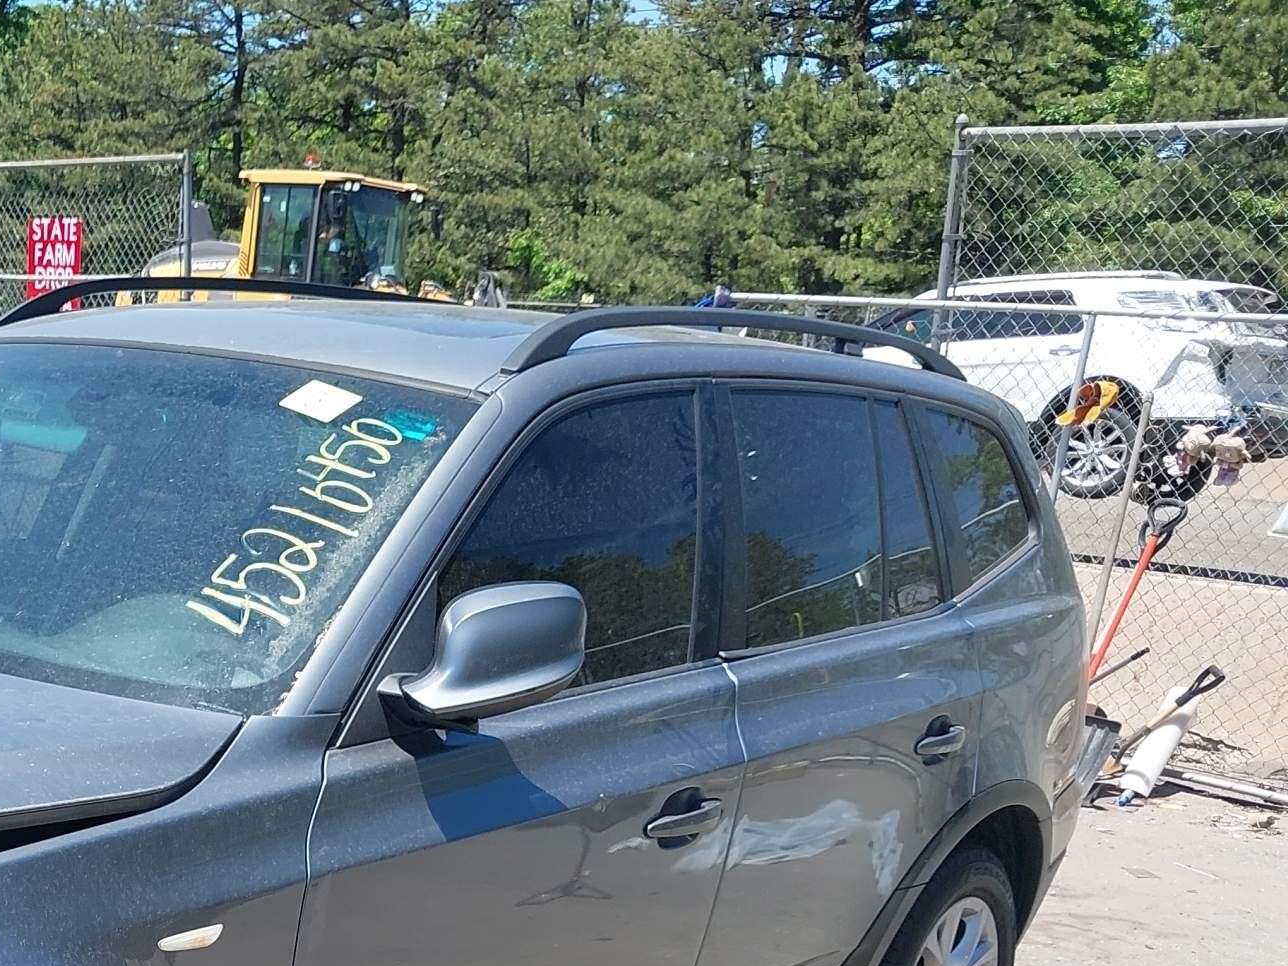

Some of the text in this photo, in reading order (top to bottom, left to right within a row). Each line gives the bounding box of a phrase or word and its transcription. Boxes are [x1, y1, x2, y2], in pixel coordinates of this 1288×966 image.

[32, 217, 78, 242] STATE
[34, 242, 75, 266] FARM
[34, 266, 74, 290] DROP
[185, 417, 403, 635] 45210450
